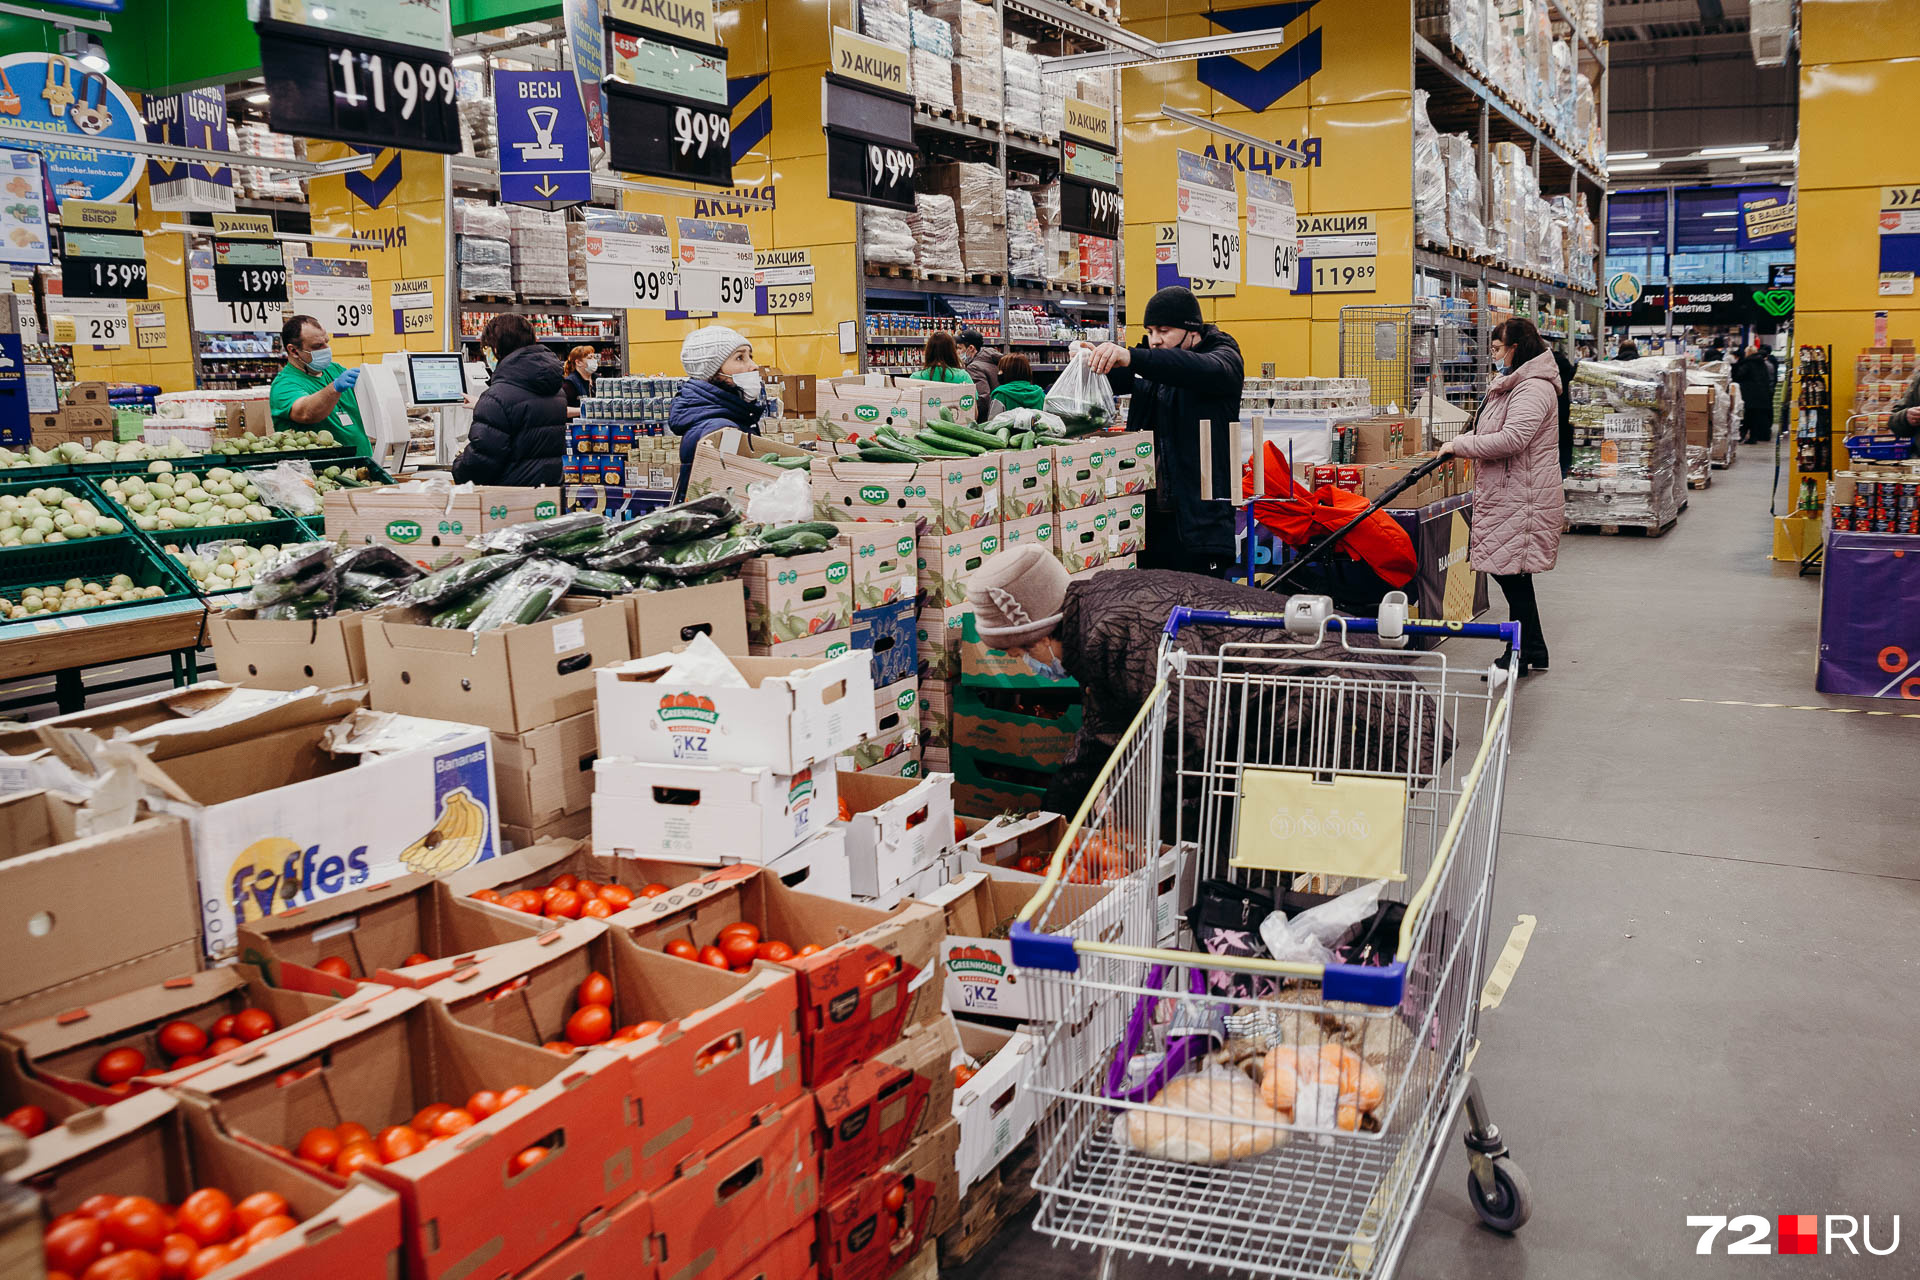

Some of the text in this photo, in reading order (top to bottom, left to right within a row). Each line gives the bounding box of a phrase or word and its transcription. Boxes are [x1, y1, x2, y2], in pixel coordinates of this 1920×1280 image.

[641, 0, 706, 32] АКЦИЯ
[855, 54, 901, 84] АКЦИЯ
[518, 81, 561, 98] ВЕСЫ
[147, 96, 178, 125] цену
[188, 95, 223, 132] цену
[1077, 113, 1107, 134] АКЦИЯ
[1203, 137, 1322, 176] АКЦИЯ
[694, 186, 776, 219] АКЦИЯ
[82, 207, 117, 216] ОТЛИЧНЫЙ
[82, 213, 117, 224] ВЫБОР
[1311, 216, 1368, 233] АКЦИЯ
[231, 222, 269, 233] АКЦИЯ
[350, 225, 407, 253] АКЦИЯ
[767, 251, 805, 266] АКЦИЯ
[401, 280, 428, 292] АКЦИЯ
[140, 303, 161, 313] АКЦИЯ
[961, 398, 973, 408] РОСТ
[857, 408, 877, 418] РОСТ
[1136, 445, 1151, 455] РОСТ
[1091, 454, 1103, 466] РОСТ
[1037, 461, 1050, 473] РОСТ
[983, 470, 997, 482] РОСТ
[862, 488, 887, 499] РОСТ
[536, 504, 556, 517] РОСТ
[1131, 505, 1144, 517] РОСТ
[1095, 515, 1107, 529] РОСТ
[390, 525, 418, 537] РОСТ
[1037, 525, 1051, 538] РОСТ
[898, 541, 913, 552] РОСТ
[981, 539, 997, 551] РОСТ
[827, 566, 847, 578] РОСТ
[899, 692, 916, 705] РОСТ
[661, 708, 717, 720] GREENHOUSE
[684, 736, 708, 752] KZ
[435, 748, 486, 773] Bananas
[902, 762, 918, 776] РОСТ
[231, 843, 370, 925] fyffes
[950, 959, 1003, 975] GREENHOUSE
[974, 986, 998, 1002] KZ
